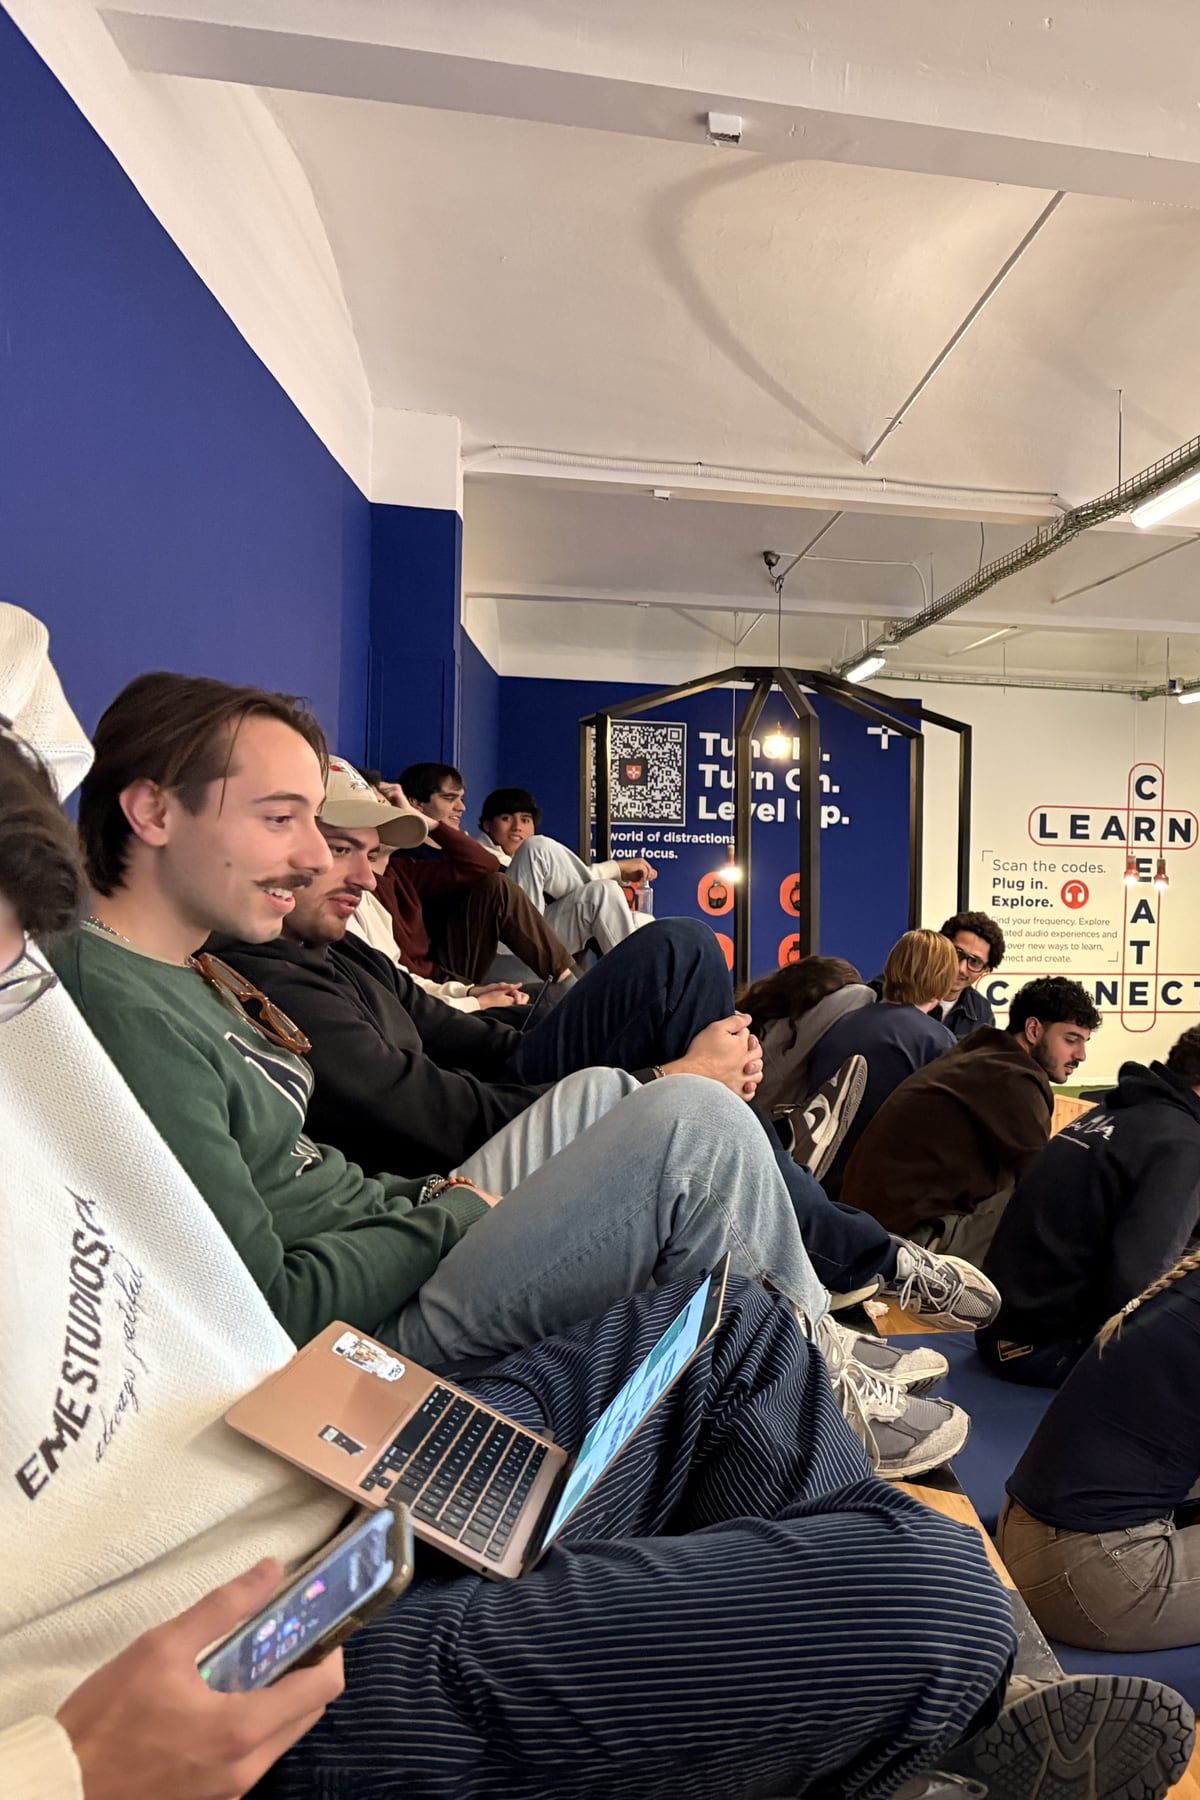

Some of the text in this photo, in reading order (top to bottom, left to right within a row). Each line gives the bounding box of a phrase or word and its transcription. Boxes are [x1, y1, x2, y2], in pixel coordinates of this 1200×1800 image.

[698, 763, 774, 791] Tun
[796, 799, 850, 829] p.
[1038, 813, 1192, 843] LEARN
[647, 832, 661, 843] of
[610, 848, 637, 860] your
[641, 847, 679, 859] focus.
[992, 859, 1107, 874] Scan the codes.
[992, 877, 1049, 892] Plug in.
[1129, 775, 1158, 1006] CREATE
[991, 895, 1054, 909] Explore.
[1012, 918, 1031, 928] your
[1033, 916, 1077, 928] frequency.
[1078, 917, 1111, 928] Explore
[1025, 929, 1049, 938] audio
[1051, 930, 1100, 940] experiences
[1102, 930, 1118, 940] and
[1028, 943, 1046, 951] new
[1048, 943, 1069, 953] ways
[1071, 942, 1080, 951] to
[1026, 953, 1043, 963] and
[1044, 954, 1073, 964] create.
